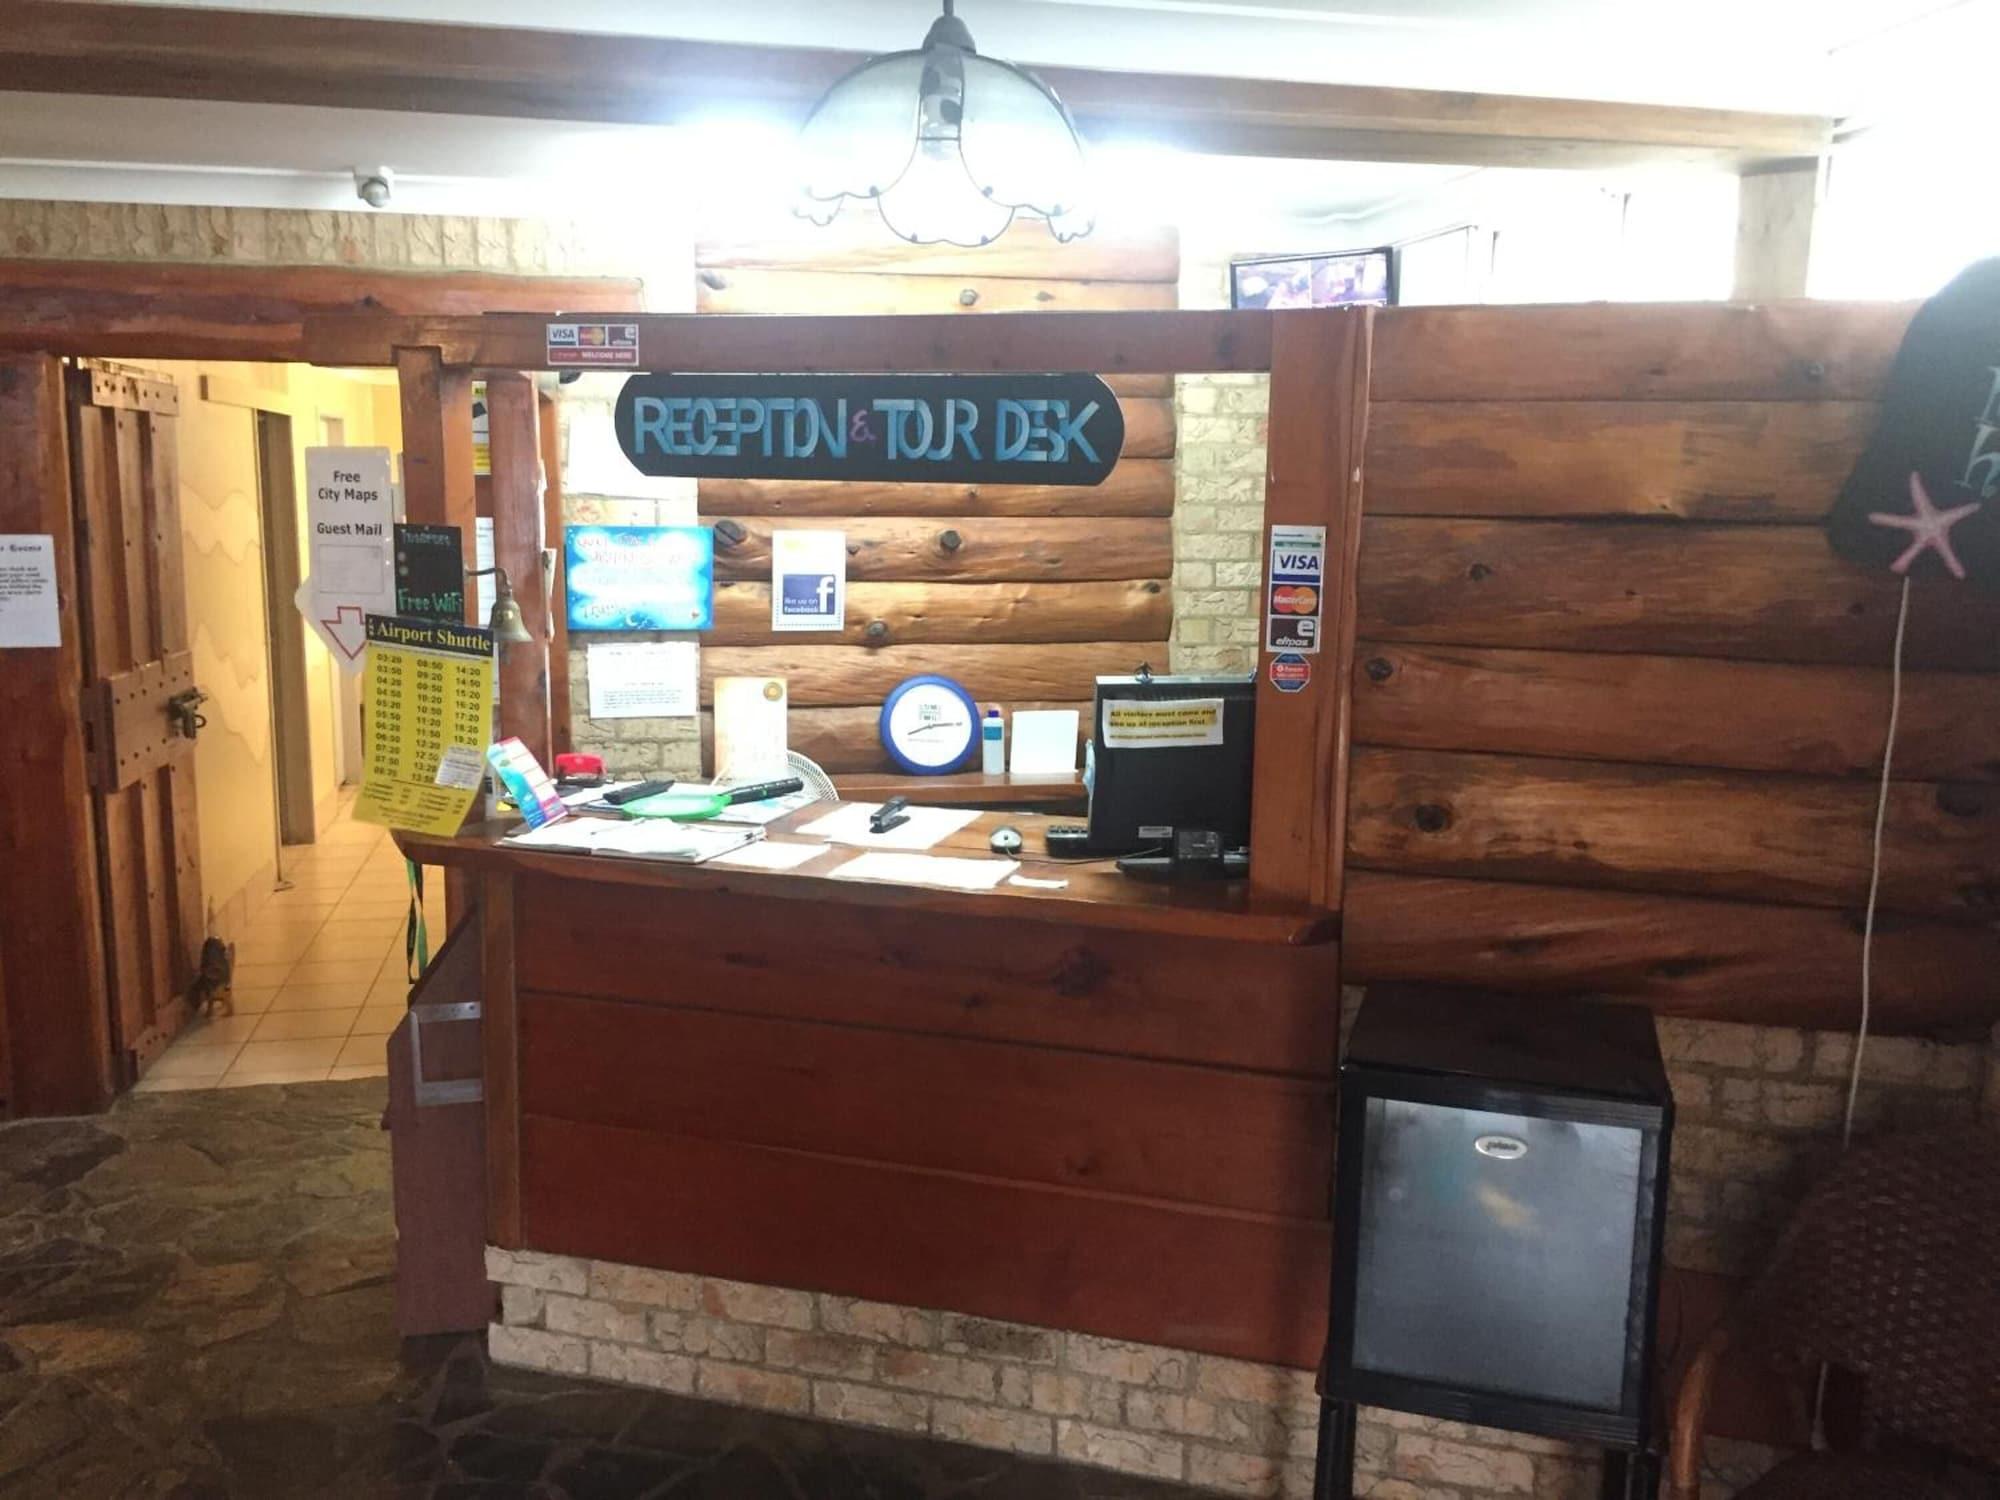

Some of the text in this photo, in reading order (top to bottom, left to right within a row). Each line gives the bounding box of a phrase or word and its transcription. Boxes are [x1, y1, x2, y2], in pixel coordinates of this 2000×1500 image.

[552, 328, 575, 339] VISA
[634, 397, 1102, 463] RECEPTION & TOUR DESK
[333, 470, 361, 483] Free
[318, 487, 378, 504] City Maps
[317, 522, 383, 537] Guest Mail
[1280, 555, 1319, 570] VISA
[398, 587, 430, 611] Free
[377, 621, 433, 643] Airport
[436, 629, 491, 651] Shuttle
[456, 666, 481, 676] 14:20
[455, 712, 479, 722] 17:20
